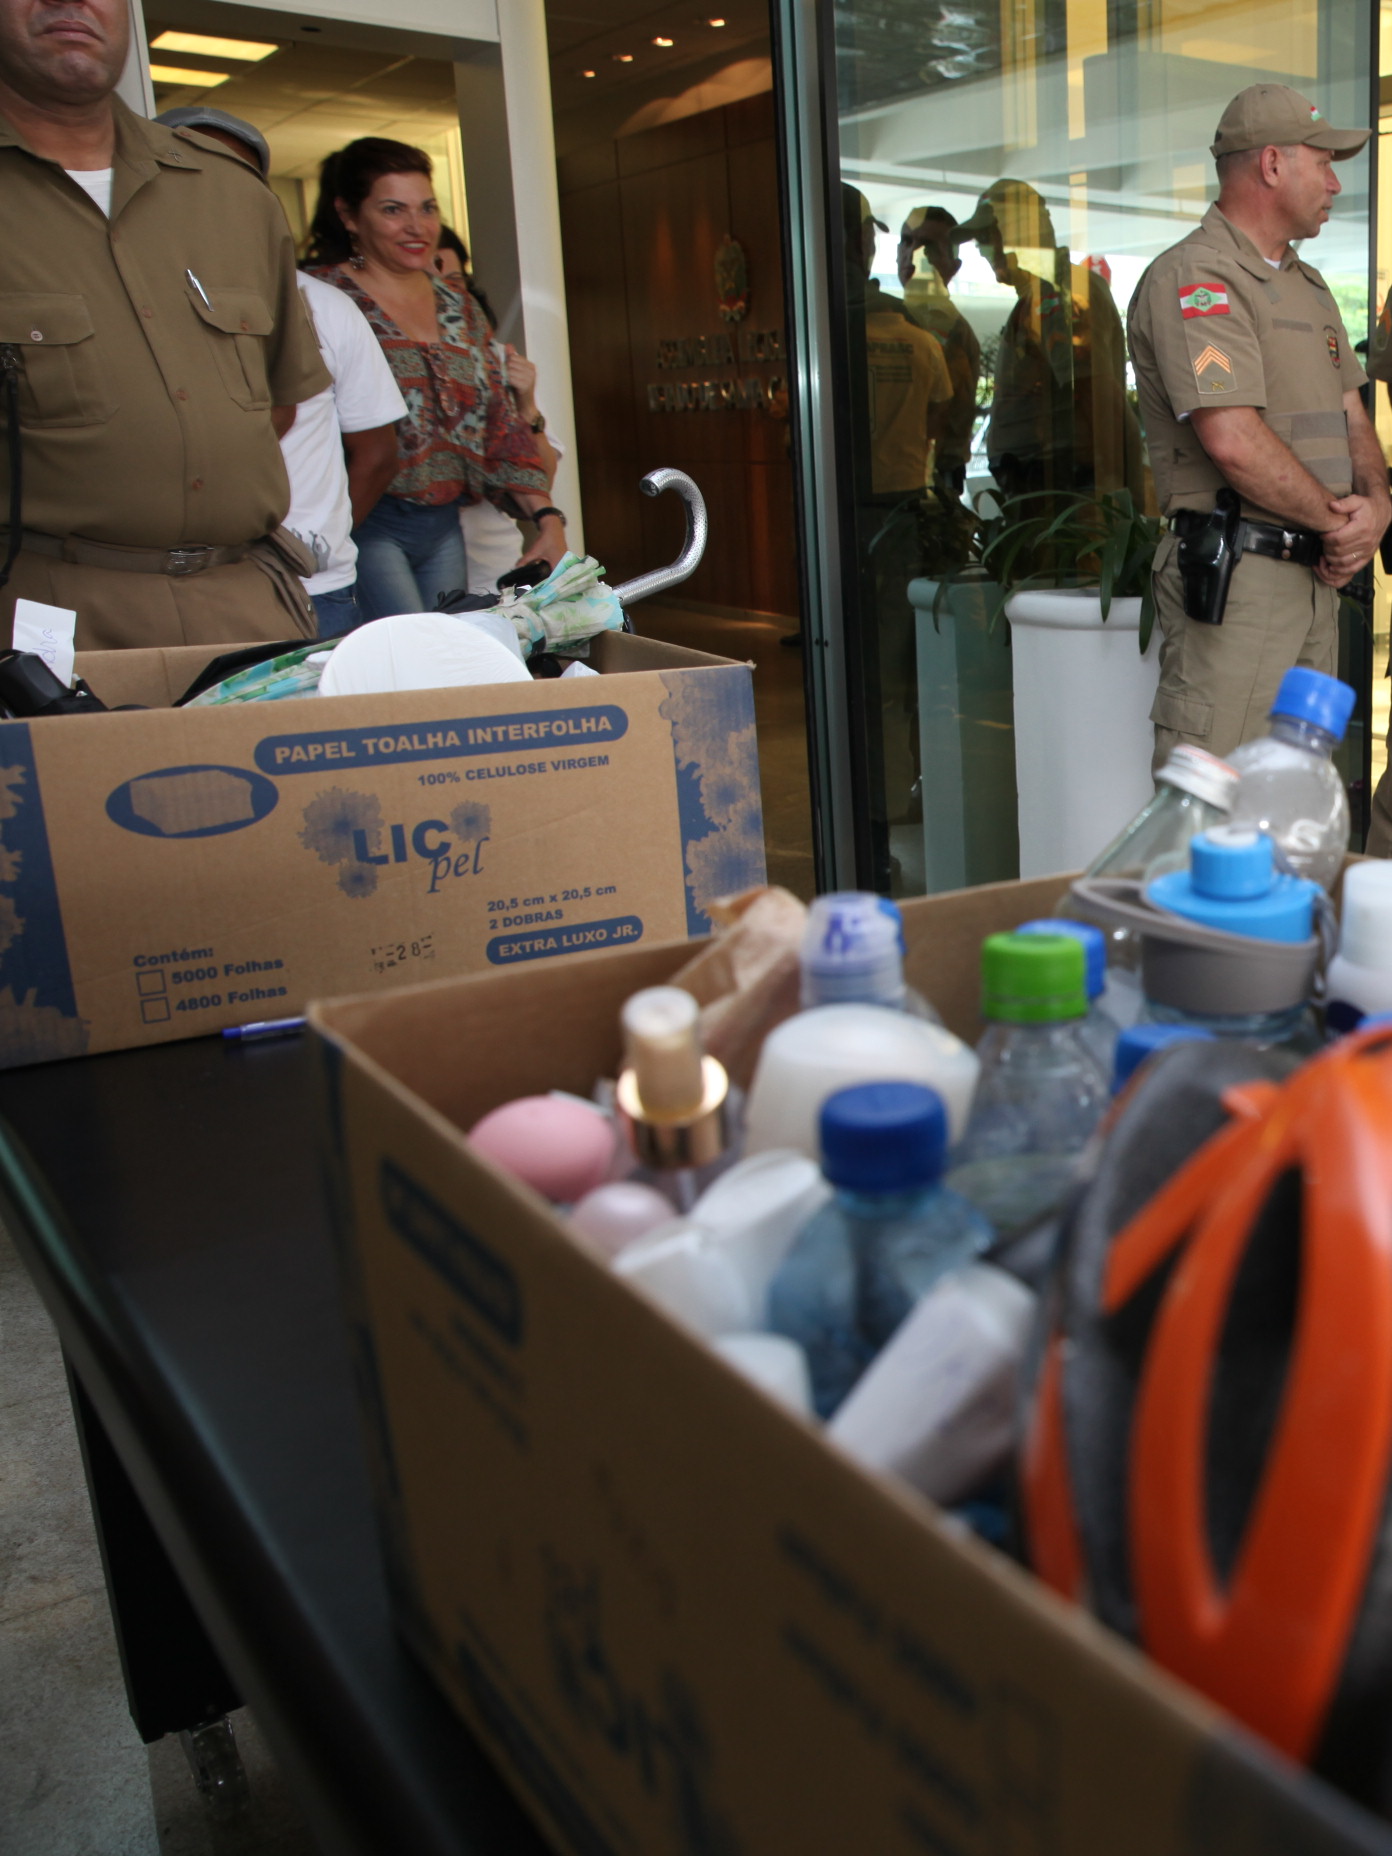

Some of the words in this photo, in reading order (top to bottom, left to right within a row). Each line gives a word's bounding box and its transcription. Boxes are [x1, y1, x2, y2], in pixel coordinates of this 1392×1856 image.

[274, 740, 355, 765] PAPEL
[362, 730, 461, 756] TOALHA
[466, 715, 613, 745] INTERFOLHA
[417, 770, 461, 787] 100%
[464, 760, 547, 781] CELULOSE
[551, 754, 610, 772] VIRGEM
[352, 819, 452, 865] LIC
[426, 836, 491, 894] pel
[487, 897, 519, 912] 20,5
[522, 895, 545, 907] cm
[548, 893, 558, 903] x
[561, 886, 592, 901] 20,5
[595, 885, 617, 896] cm
[489, 918, 499, 930] 2
[502, 908, 564, 928] DOBRAS
[498, 937, 558, 957] EXTRA
[561, 928, 608, 947] LUXO
[612, 924, 639, 938] JR.
[133, 946, 214, 968] Contém:
[171, 967, 218, 985] 5000
[223, 957, 284, 977] Folhas
[175, 993, 222, 1013] 4800
[227, 984, 288, 1004] Folhas
